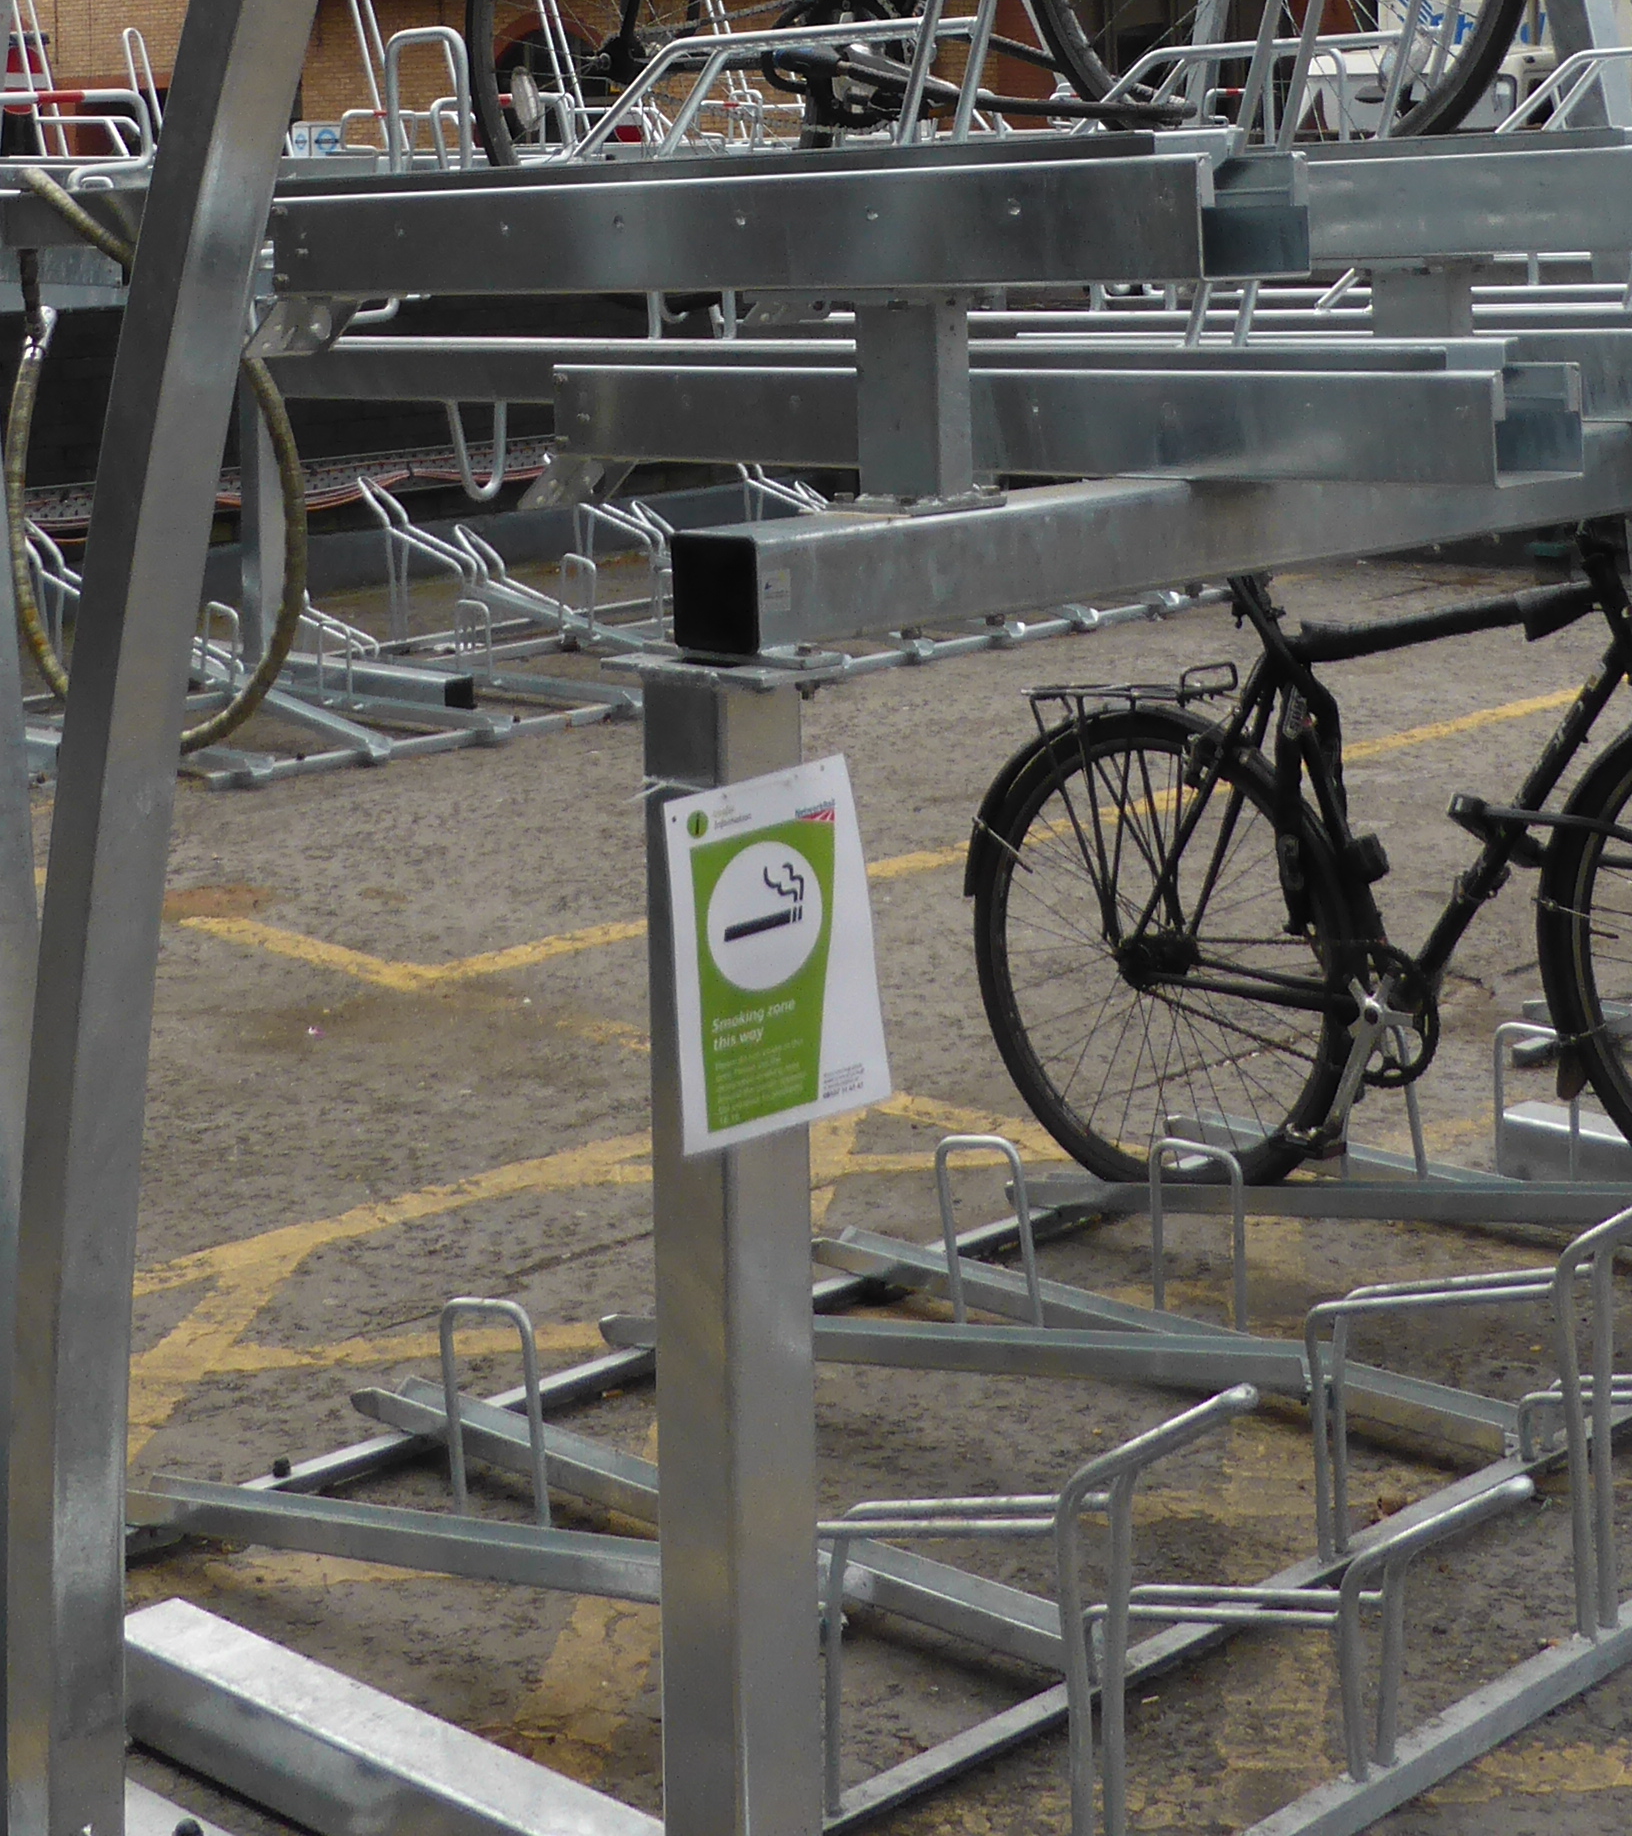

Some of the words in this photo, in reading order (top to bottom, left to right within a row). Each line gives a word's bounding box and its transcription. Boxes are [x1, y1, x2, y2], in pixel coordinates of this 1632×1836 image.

[711, 1007, 765, 1033] Smoking
[767, 998, 797, 1018] zone
[713, 1034, 737, 1051] this
[739, 1026, 765, 1043] way
